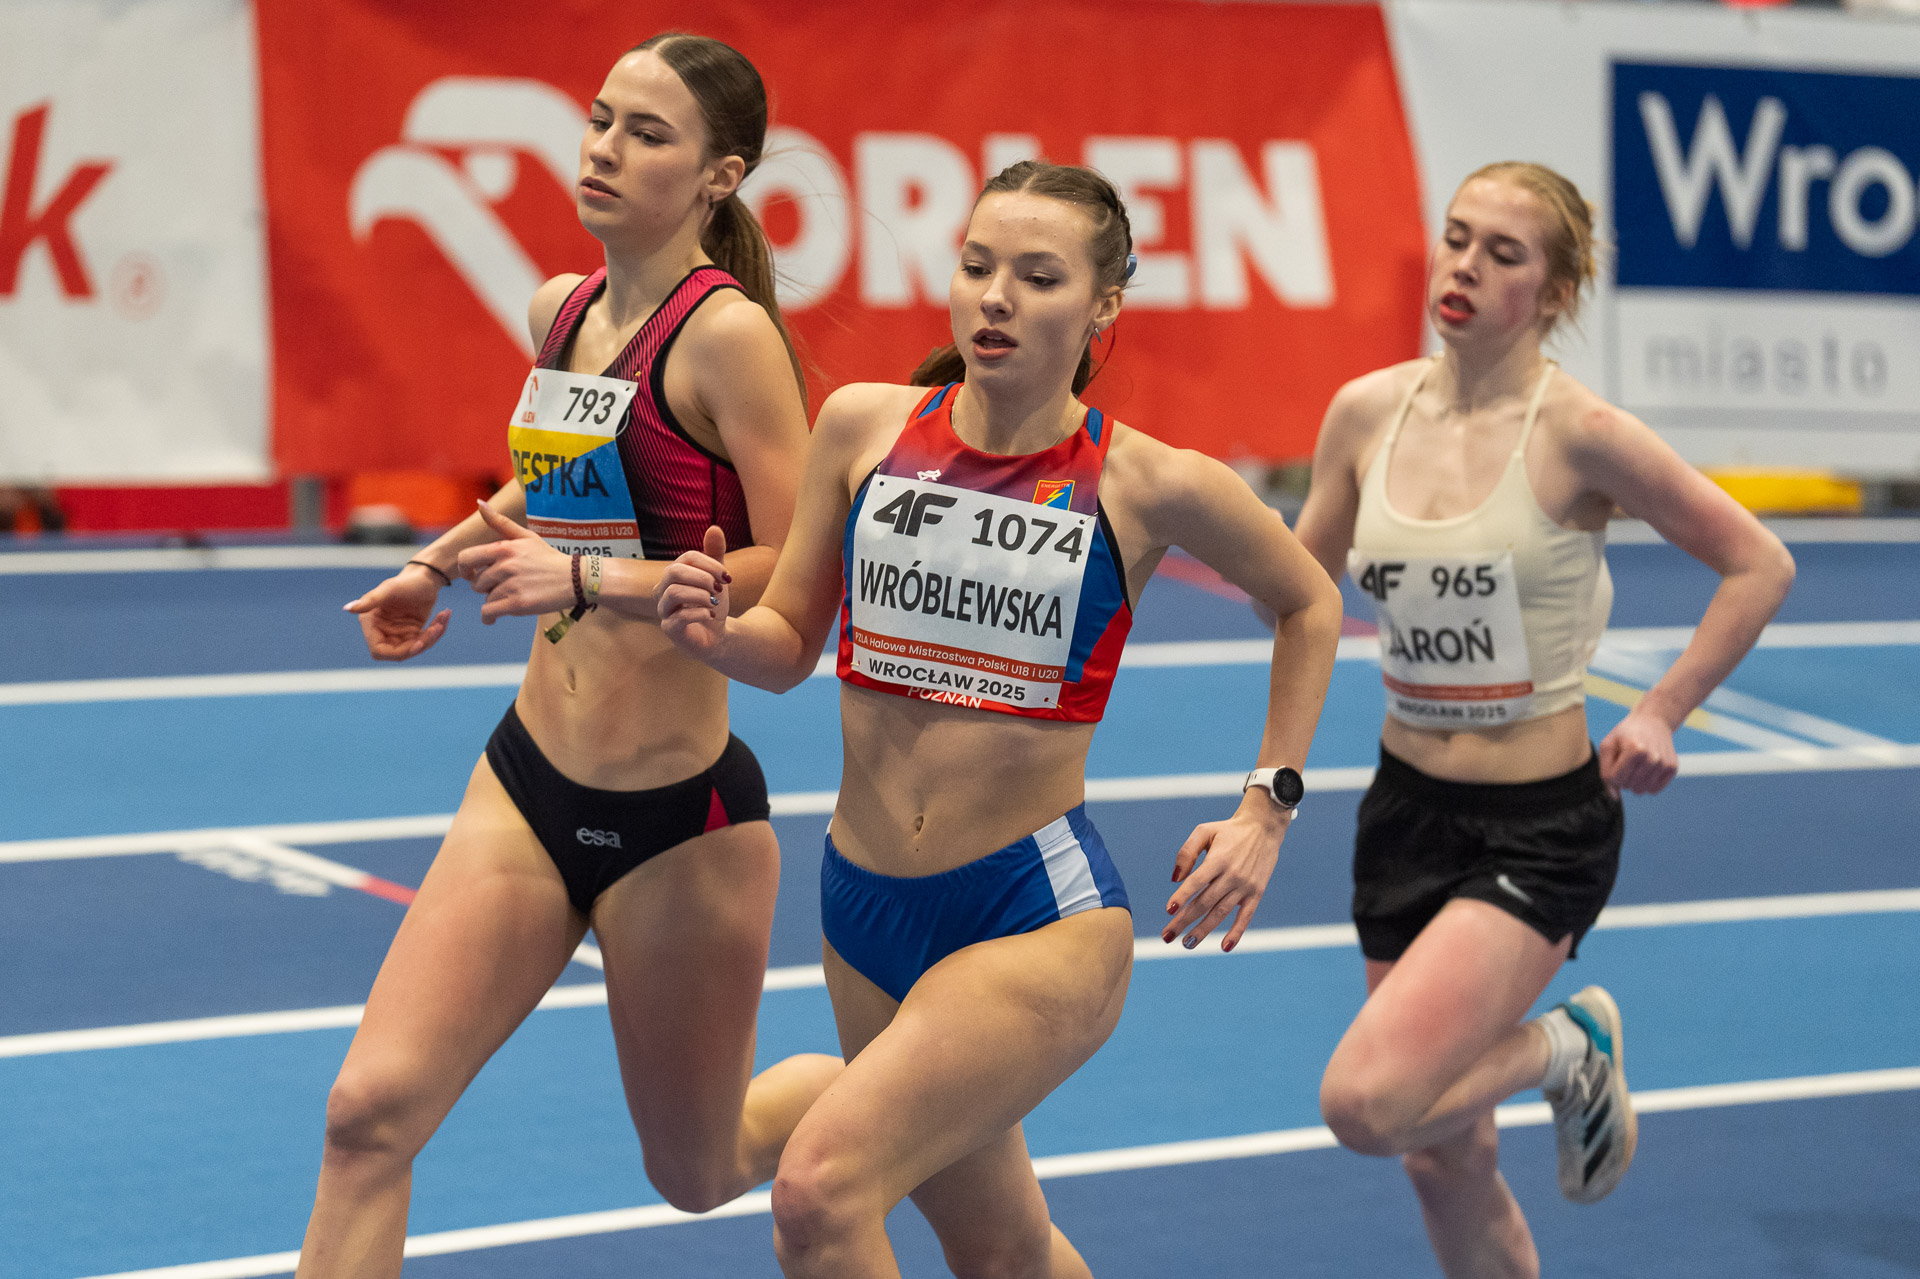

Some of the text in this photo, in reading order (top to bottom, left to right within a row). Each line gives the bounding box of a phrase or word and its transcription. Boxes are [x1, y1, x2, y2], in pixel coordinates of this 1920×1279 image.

[1637, 90, 1920, 258] Wro
[737, 125, 1335, 311] OREN
[563, 387, 616, 424] 793
[568, 527, 591, 536] Polski
[593, 526, 608, 536] U18
[616, 526, 633, 536] U20
[971, 508, 1083, 563] 1074
[860, 558, 1062, 639] WRÓBLEWSKA
[1431, 564, 1497, 599] 965
[855, 631, 1059, 680] PZLA Halowe Mistrzostwa Polski U18 i U20
[869, 657, 1026, 701] WROCŁAW 2025
[576, 827, 623, 849] esa
